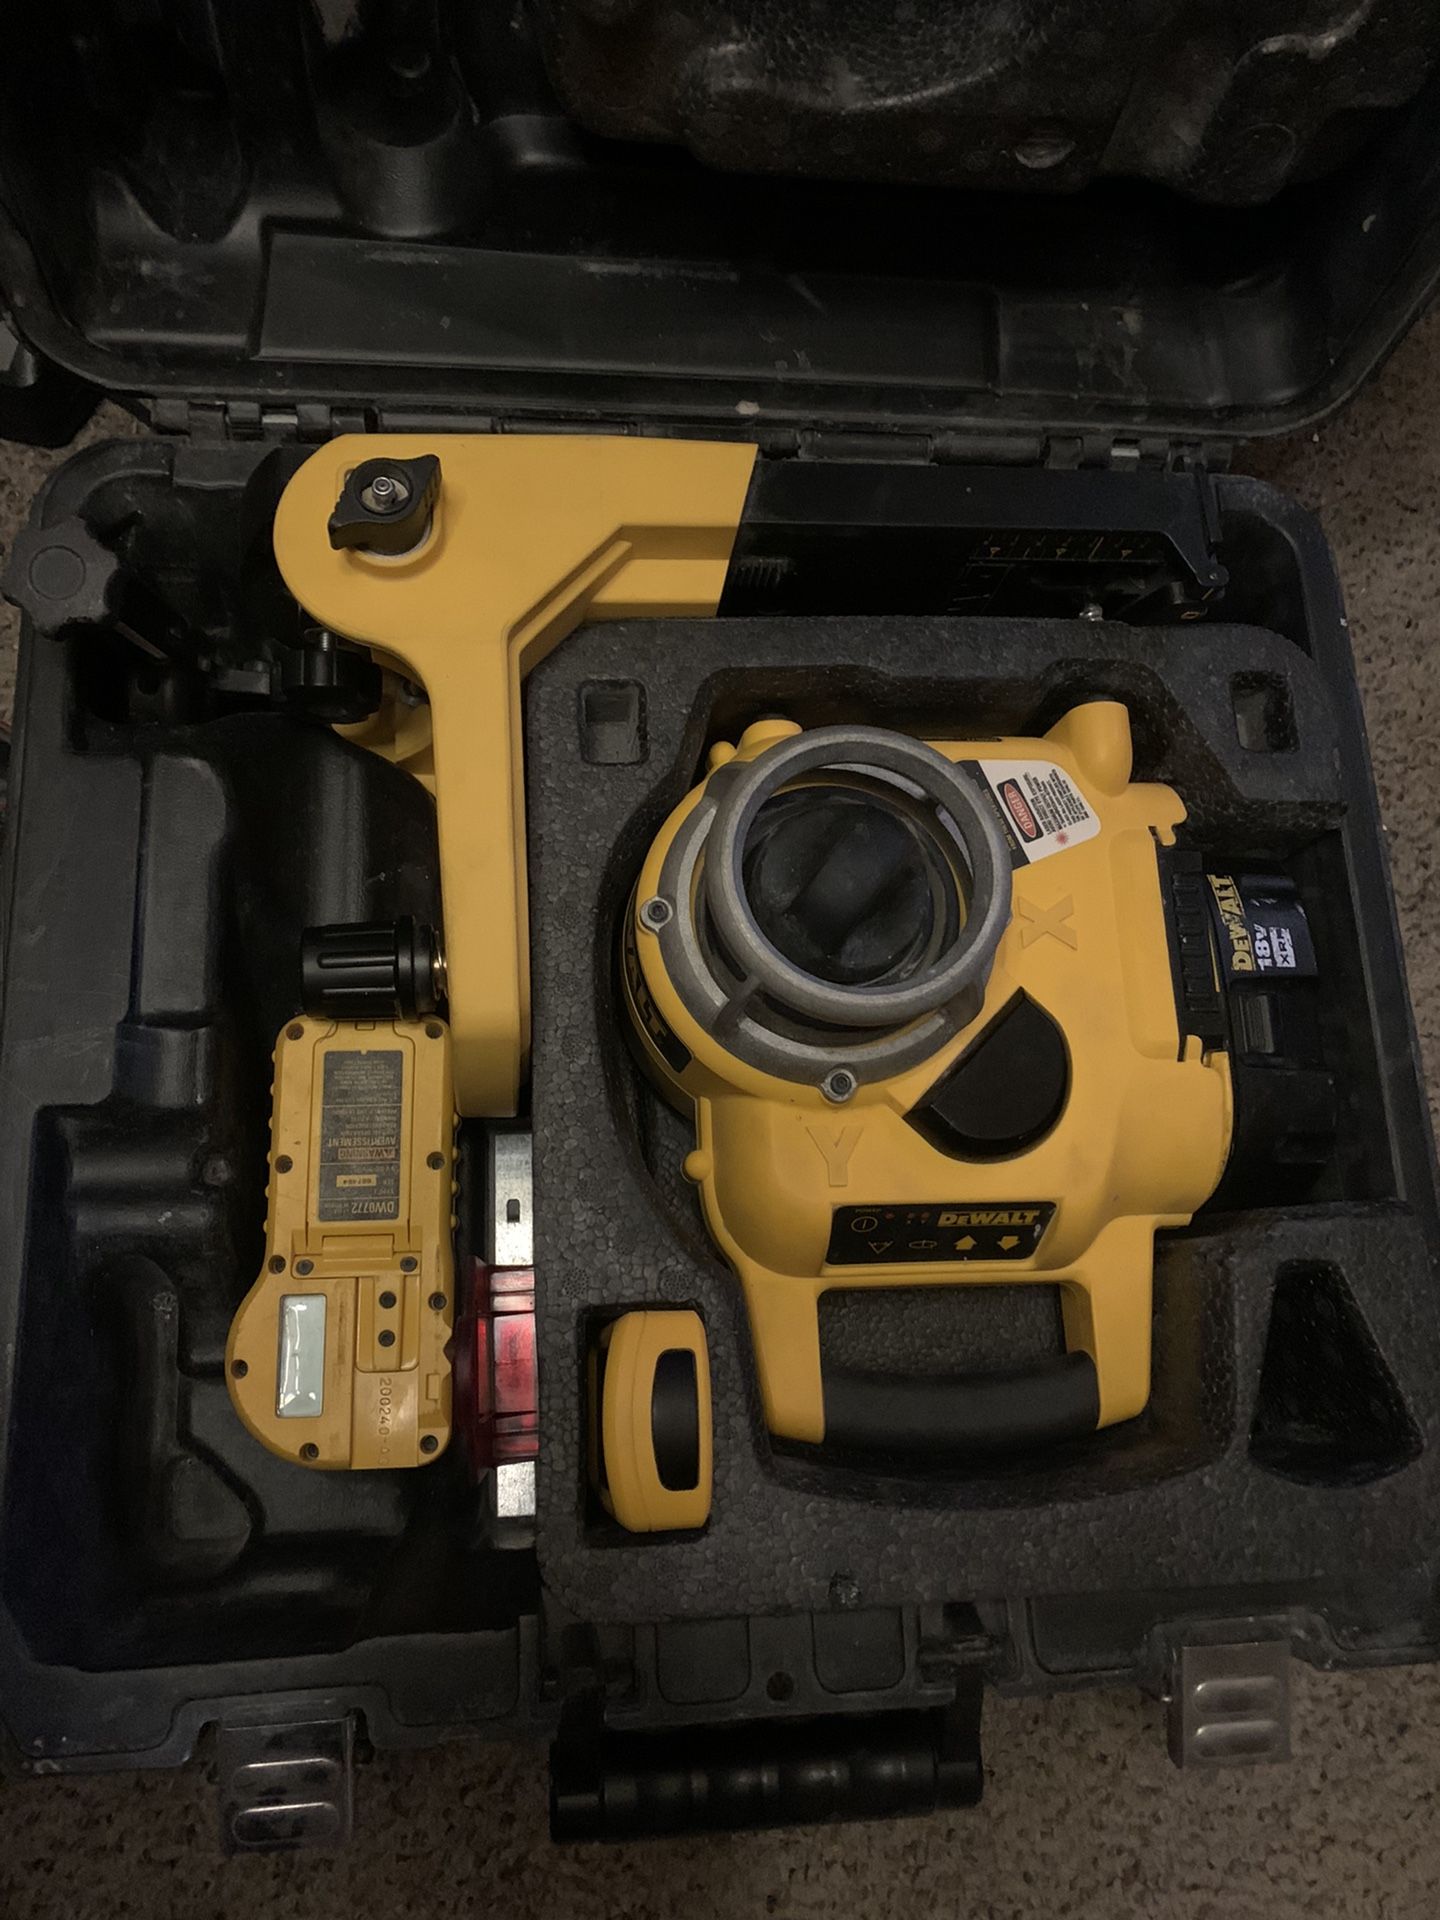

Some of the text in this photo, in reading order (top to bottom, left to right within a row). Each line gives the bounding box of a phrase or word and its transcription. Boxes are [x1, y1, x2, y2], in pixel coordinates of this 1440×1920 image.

[1009, 790, 1033, 829] DANGER
[1016, 893, 1078, 951] X
[1207, 874, 1256, 972] DEWALT
[1254, 923, 1273, 971] 18V
[327, 1136, 396, 1147] AVERTISSEMENT
[340, 1149, 385, 1159] WARNING
[806, 1125, 863, 1188] Y
[351, 1201, 395, 1214] DW0772
[938, 1210, 1040, 1228] DEWALT
